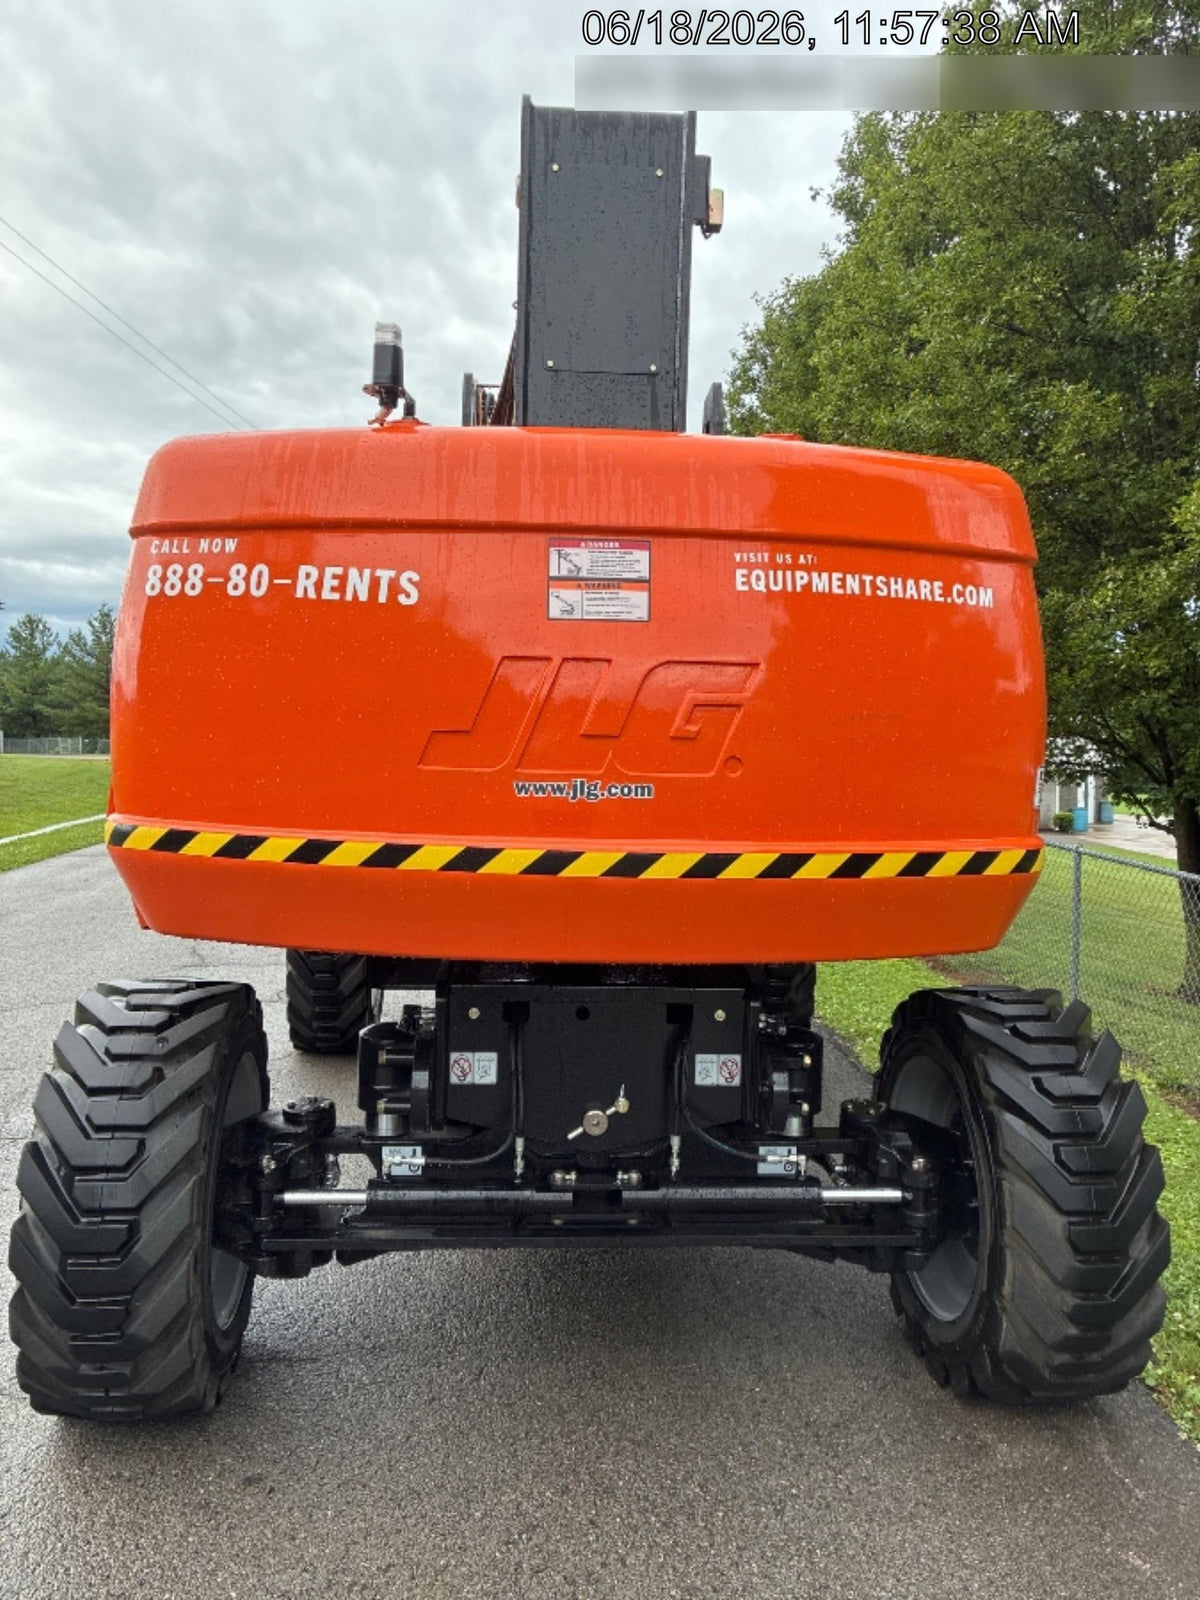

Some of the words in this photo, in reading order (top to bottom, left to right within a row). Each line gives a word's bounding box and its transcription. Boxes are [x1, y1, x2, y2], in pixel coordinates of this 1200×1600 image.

[150, 539, 190, 554] CALL
[199, 538, 239, 554] NOW
[733, 552, 769, 563] VISIT
[776, 552, 793, 564] US
[144, 563, 421, 606] 888-80-RENTS
[735, 568, 994, 608] EQUIPMENTSHARE.COM
[514, 779, 654, 801] www.jlg.com
